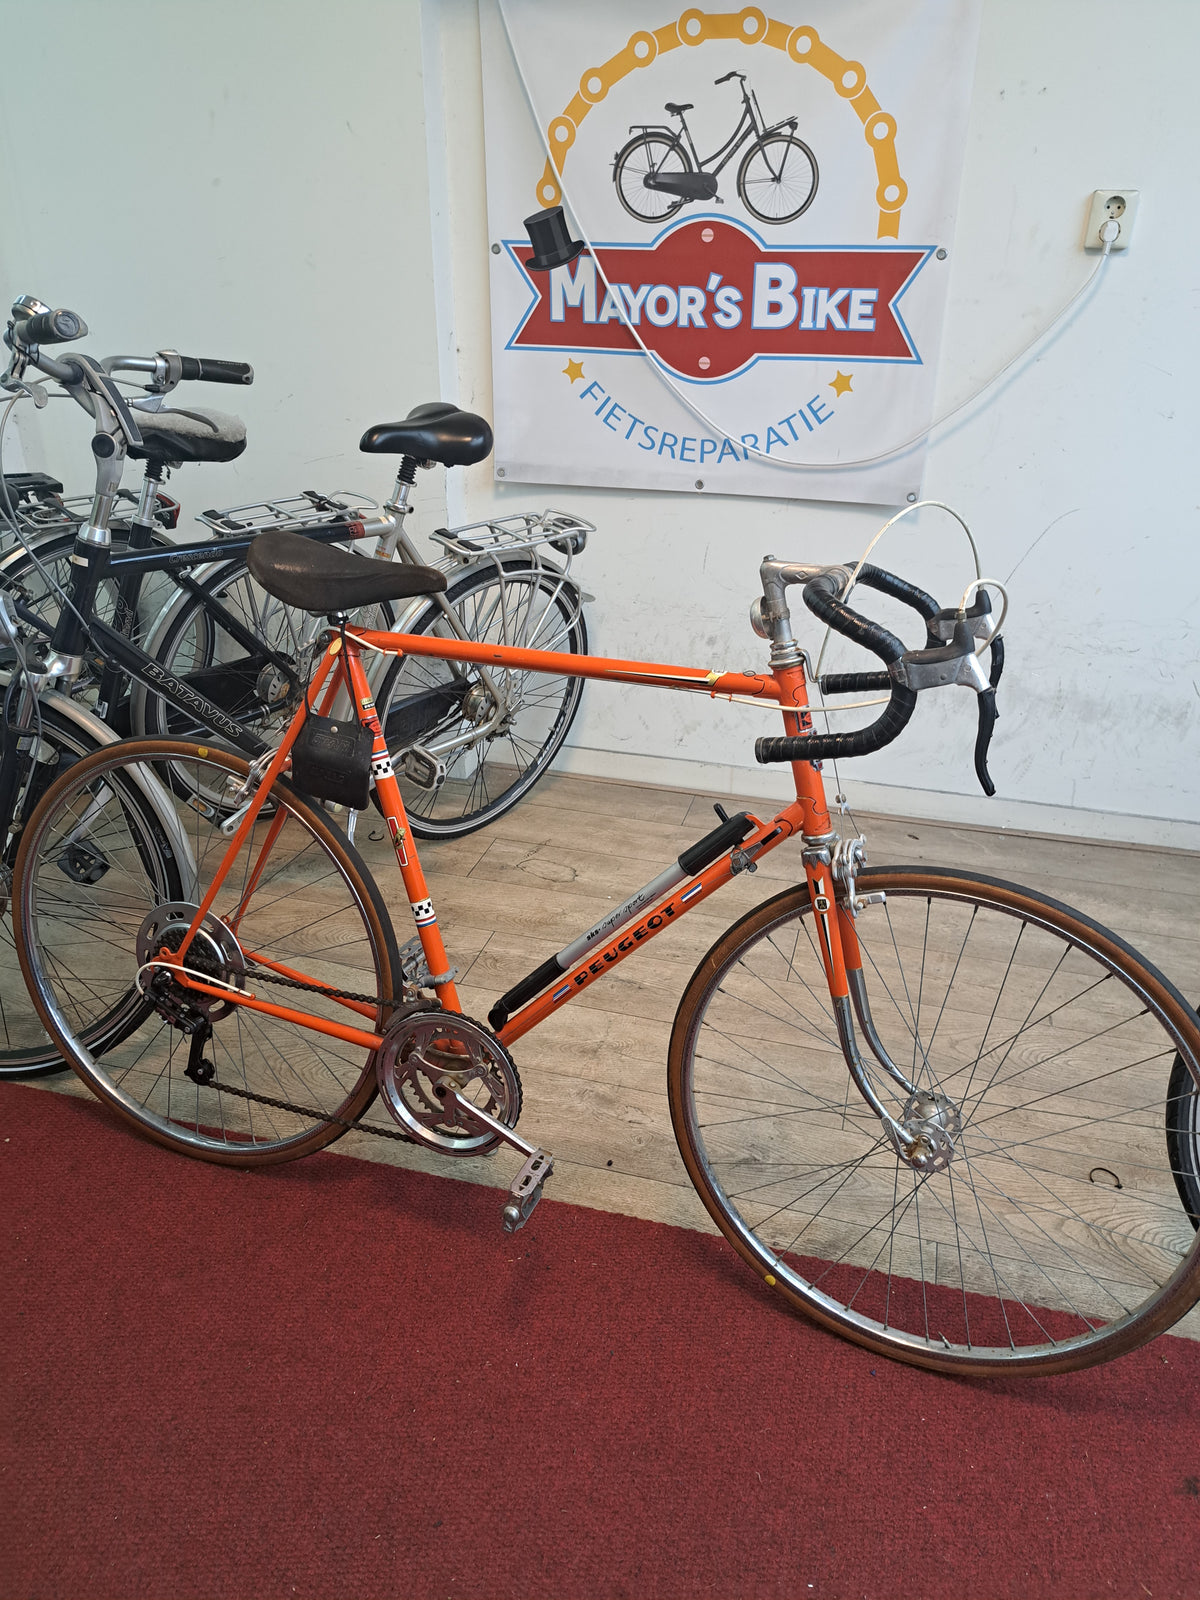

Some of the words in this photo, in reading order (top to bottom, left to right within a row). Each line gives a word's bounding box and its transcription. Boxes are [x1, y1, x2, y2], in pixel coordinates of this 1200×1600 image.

[549, 254, 743, 329] MAYOR'S
[751, 262, 879, 331] BIKE
[580, 380, 835, 463] FIETSREPARATIE
[141, 662, 243, 737] BATAVUS
[573, 902, 675, 986] PEUGEOT
